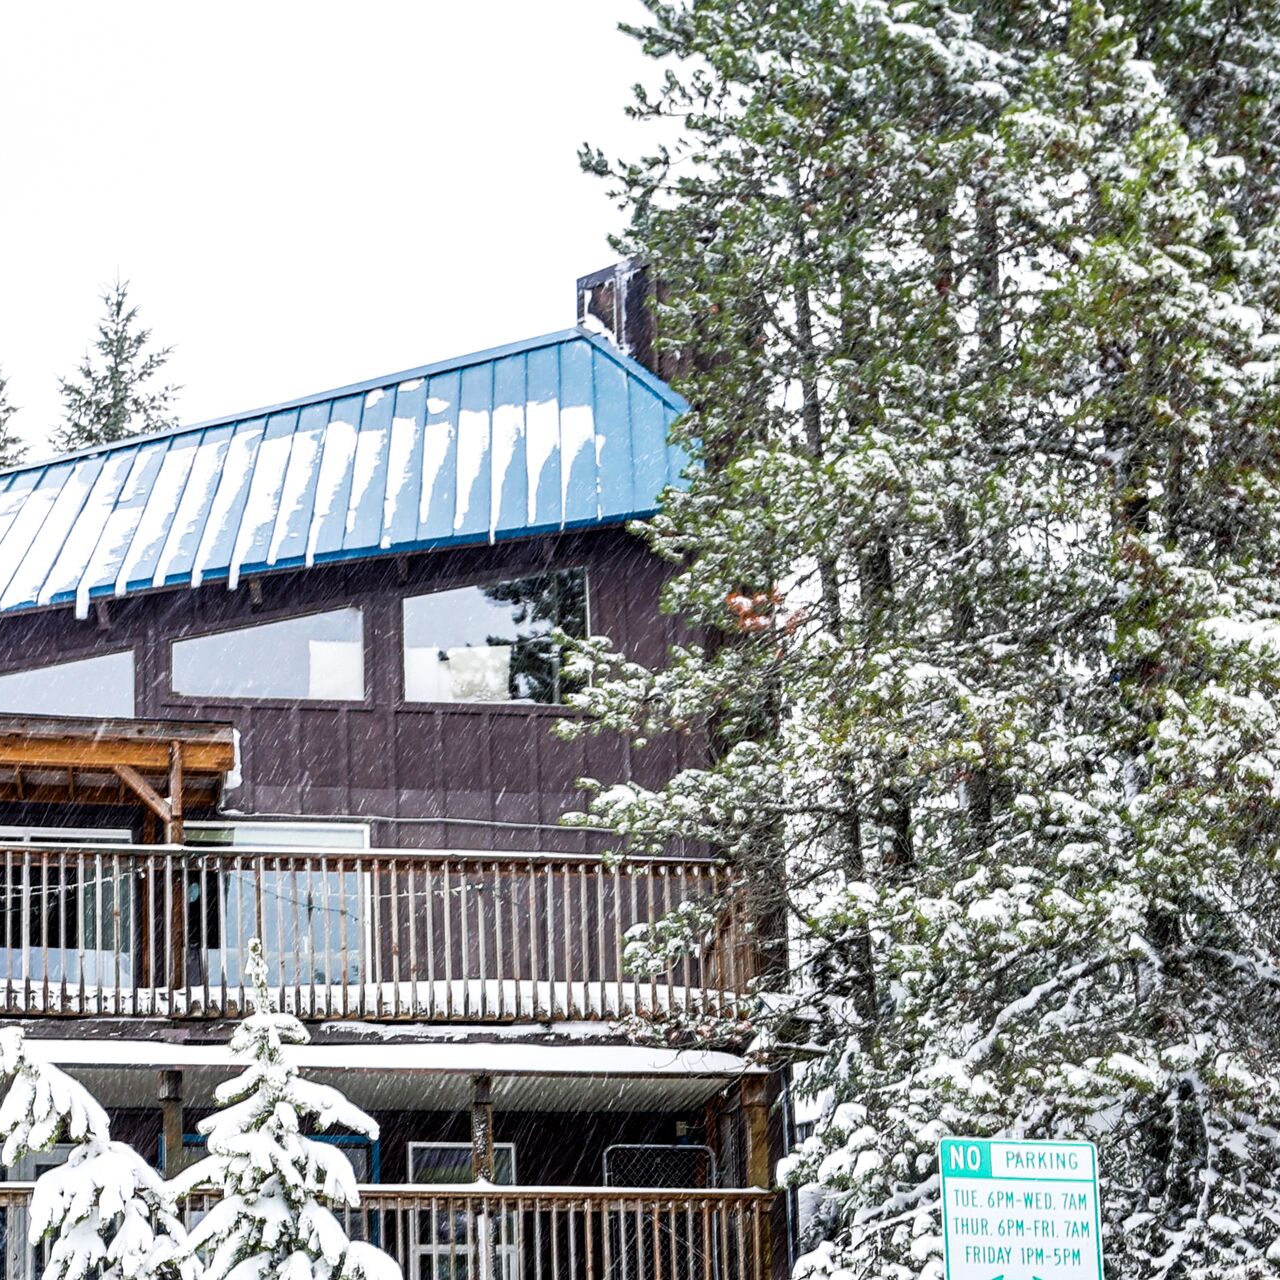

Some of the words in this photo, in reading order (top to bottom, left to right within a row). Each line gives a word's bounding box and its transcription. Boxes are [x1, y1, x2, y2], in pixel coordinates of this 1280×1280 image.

[950, 1145, 981, 1171] NO
[1005, 1151, 1078, 1171] PARKING
[953, 1189, 983, 1208] TUE.
[987, 1191, 1056, 1210] 6PM-WED.
[1063, 1193, 1088, 1210] 7AM
[953, 1217, 993, 1236] THUR.
[997, 1219, 1060, 1238] 6PM-FRI.
[1064, 1221, 1090, 1238] 7AM
[965, 1246, 1013, 1265] FRIDAY
[1021, 1248, 1081, 1266] 1PM-5PM
